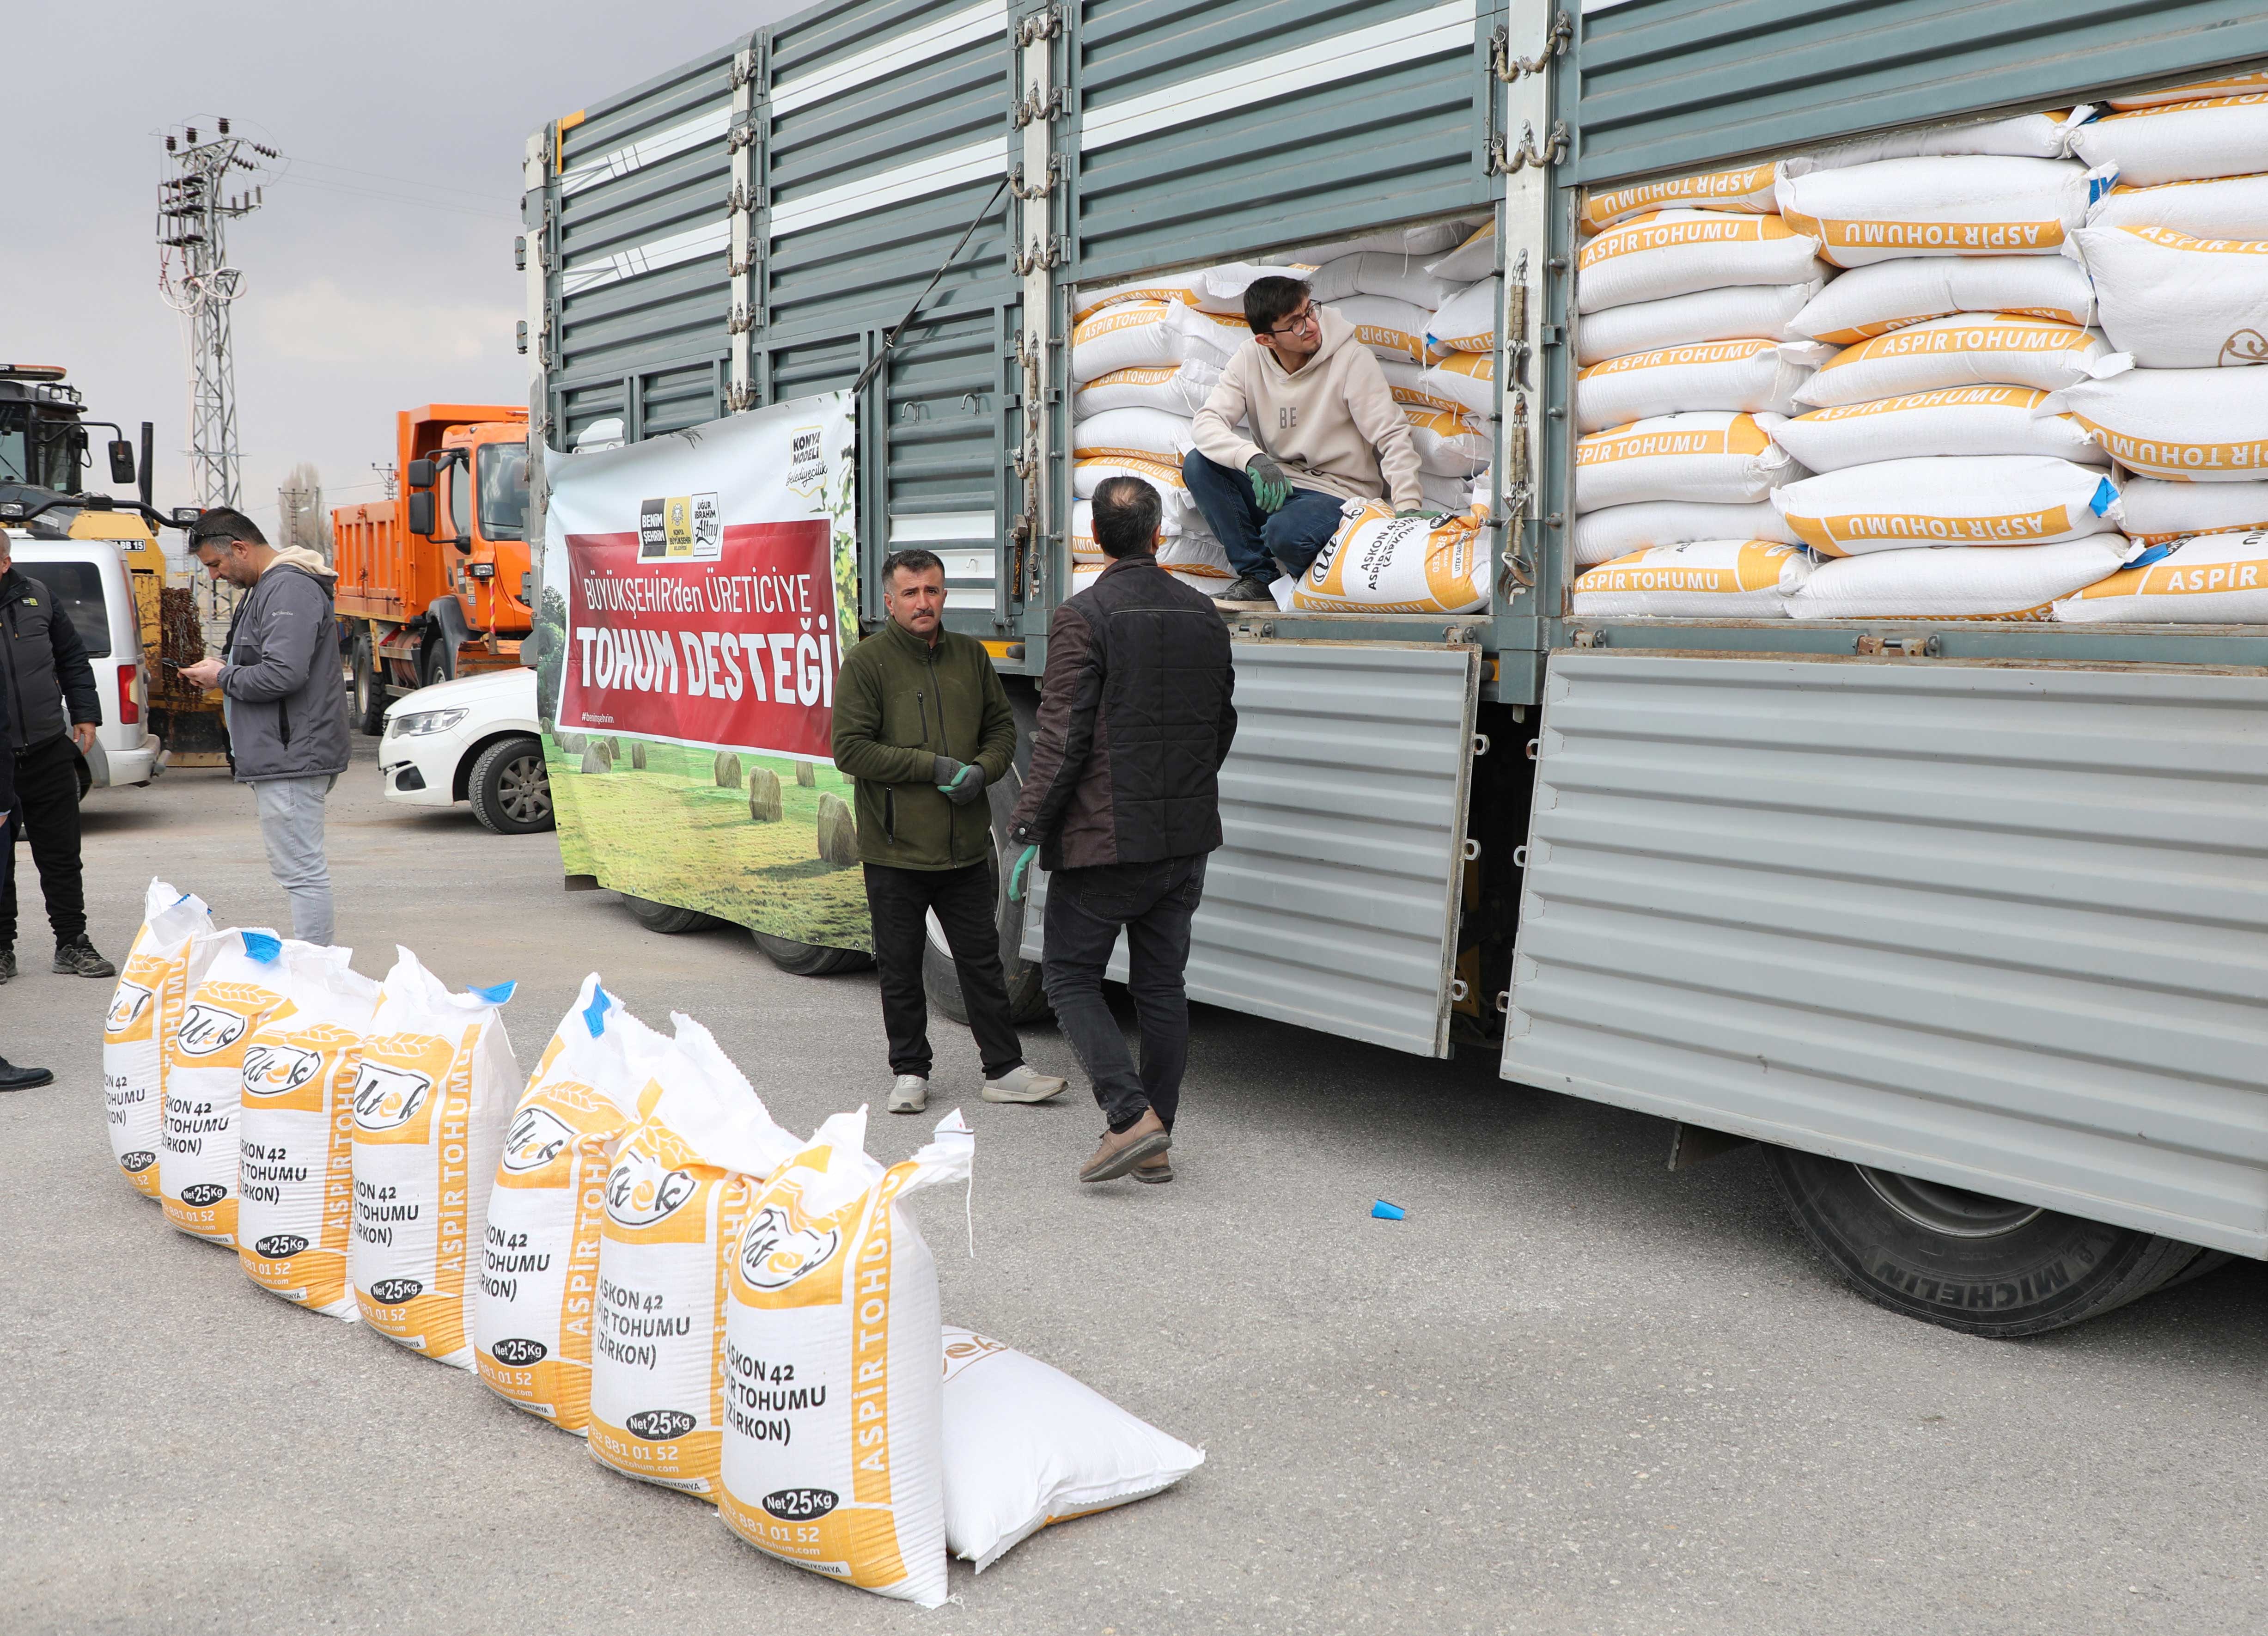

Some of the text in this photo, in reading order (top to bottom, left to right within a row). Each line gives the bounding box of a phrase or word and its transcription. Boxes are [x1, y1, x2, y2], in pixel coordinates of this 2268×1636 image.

[1697, 171, 1757, 197] ASPİR
[1585, 222, 1740, 265] ASPİR TOHUMU
[1845, 223, 2041, 249] ASPİR TOHUMU
[1084, 315, 1114, 340] ASPİR
[1360, 327, 1400, 346] ASPİR
[1882, 330, 2072, 355] ASPİR TOHUMU
[1606, 342, 1760, 372] ASPİR TOHUMU
[1126, 369, 1172, 383] TOHUMU
[1892, 389, 2012, 409] TOHUMU
[1280, 407, 1296, 429] BE
[793, 431, 821, 452] KONYA
[1576, 434, 1708, 464] SPİR TOHUMU
[2091, 428, 2223, 467] TOHUMU
[792, 446, 819, 466] MODELİ
[786, 460, 828, 488] Belediyecilik
[695, 510, 716, 519] İBRAHİM
[697, 500, 711, 509] UĞUR
[642, 513, 663, 528] BENİM
[695, 519, 719, 545] Altay
[1849, 514, 2043, 540] ASPİR TOHUMU
[133, 541, 143, 549] 15
[643, 530, 665, 544] ŞEHRİM
[1361, 532, 1389, 571] ASKON
[1576, 570, 1719, 590] ASPİR TOHUMU
[2167, 562, 2257, 591] ASPİR
[705, 566, 811, 613] ÜRETİCİYE
[1303, 598, 1349, 612] ASPİR
[576, 614, 833, 708] TOHUM DESTEĞİ
[116, 1076, 127, 1090] 42
[165, 1094, 212, 1117] SKON 42
[170, 1117, 229, 1134] TOHUMU
[162, 1131, 202, 1156] ZİRKON)
[240, 1138, 287, 1163] SKON 42
[245, 1163, 307, 1182] TOHUMU
[240, 1178, 280, 1205] ZİRKON)
[326, 1155, 352, 1230] ASPİR
[378, 1186, 396, 1203] 42
[169, 1206, 215, 1222] 881 01 52
[358, 1202, 419, 1222] TOHUMU
[439, 1188, 464, 1273] ASPİR
[507, 1233, 528, 1251] 42
[258, 1263, 271, 1275] 01
[274, 1262, 291, 1275] 52
[484, 1248, 551, 1273] TOHUMU
[567, 1239, 600, 1336] ASPİR
[600, 1275, 664, 1314] ASKON 42
[1872, 1259, 2071, 1309] MICHELIN
[375, 1308, 388, 1321] 01
[391, 1308, 406, 1321] 52
[611, 1311, 691, 1337] TOHUMU
[853, 1173, 899, 1472] ASPİR TOHUMU
[597, 1326, 657, 1371] (ZİRKON)
[727, 1337, 795, 1386] ASKON 42
[498, 1370, 512, 1385] 01
[515, 1372, 532, 1386] 52
[738, 1382, 826, 1411] TOHUMU
[726, 1398, 792, 1447] (ZİRKON)
[604, 1435, 629, 1457] 881
[633, 1446, 652, 1460] 01
[657, 1446, 678, 1461] 52
[739, 1514, 766, 1537] 881
[770, 1526, 792, 1542] 01
[797, 1526, 820, 1543] 52
